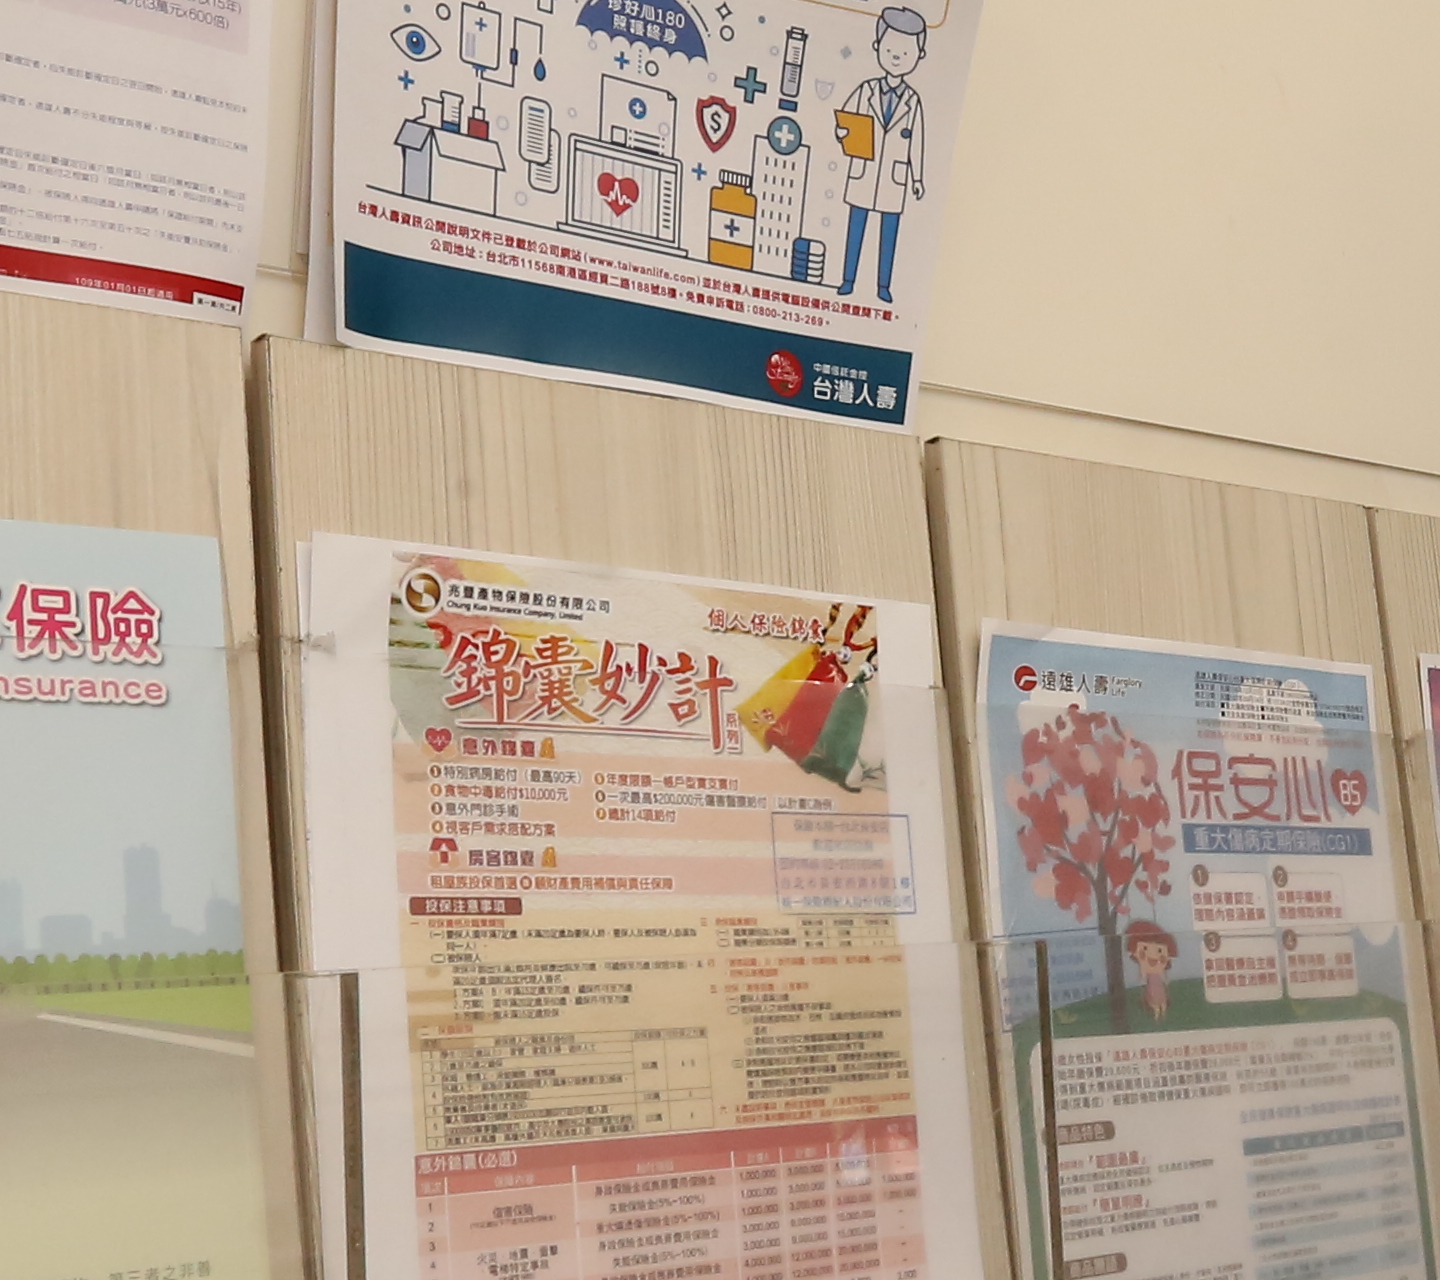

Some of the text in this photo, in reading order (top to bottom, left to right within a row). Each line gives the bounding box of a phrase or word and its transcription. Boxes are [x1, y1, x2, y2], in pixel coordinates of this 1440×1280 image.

[610, 12, 680, 47] 照護終身
[811, 378, 899, 411] 台灣人壽
[446, 581, 613, 615] 兆豐產物保險股份有限公司
[446, 599, 471, 614] Chung
[487, 603, 522, 618] Insurance
[707, 606, 827, 645] 個人保險錦囊
[441, 625, 736, 754] 錦囊妙計
[1041, 669, 1109, 696] 遠雄人壽
[461, 736, 537, 758] 意外錦囊
[1170, 746, 1333, 824] 保安心
[1338, 777, 1362, 808] 85
[444, 800, 520, 820] 意外門診手術
[1193, 826, 1359, 855] 重大傷病定期保險(CG1)
[468, 847, 536, 868] 房客錦囊
[424, 897, 507, 915] 投保注意事項
